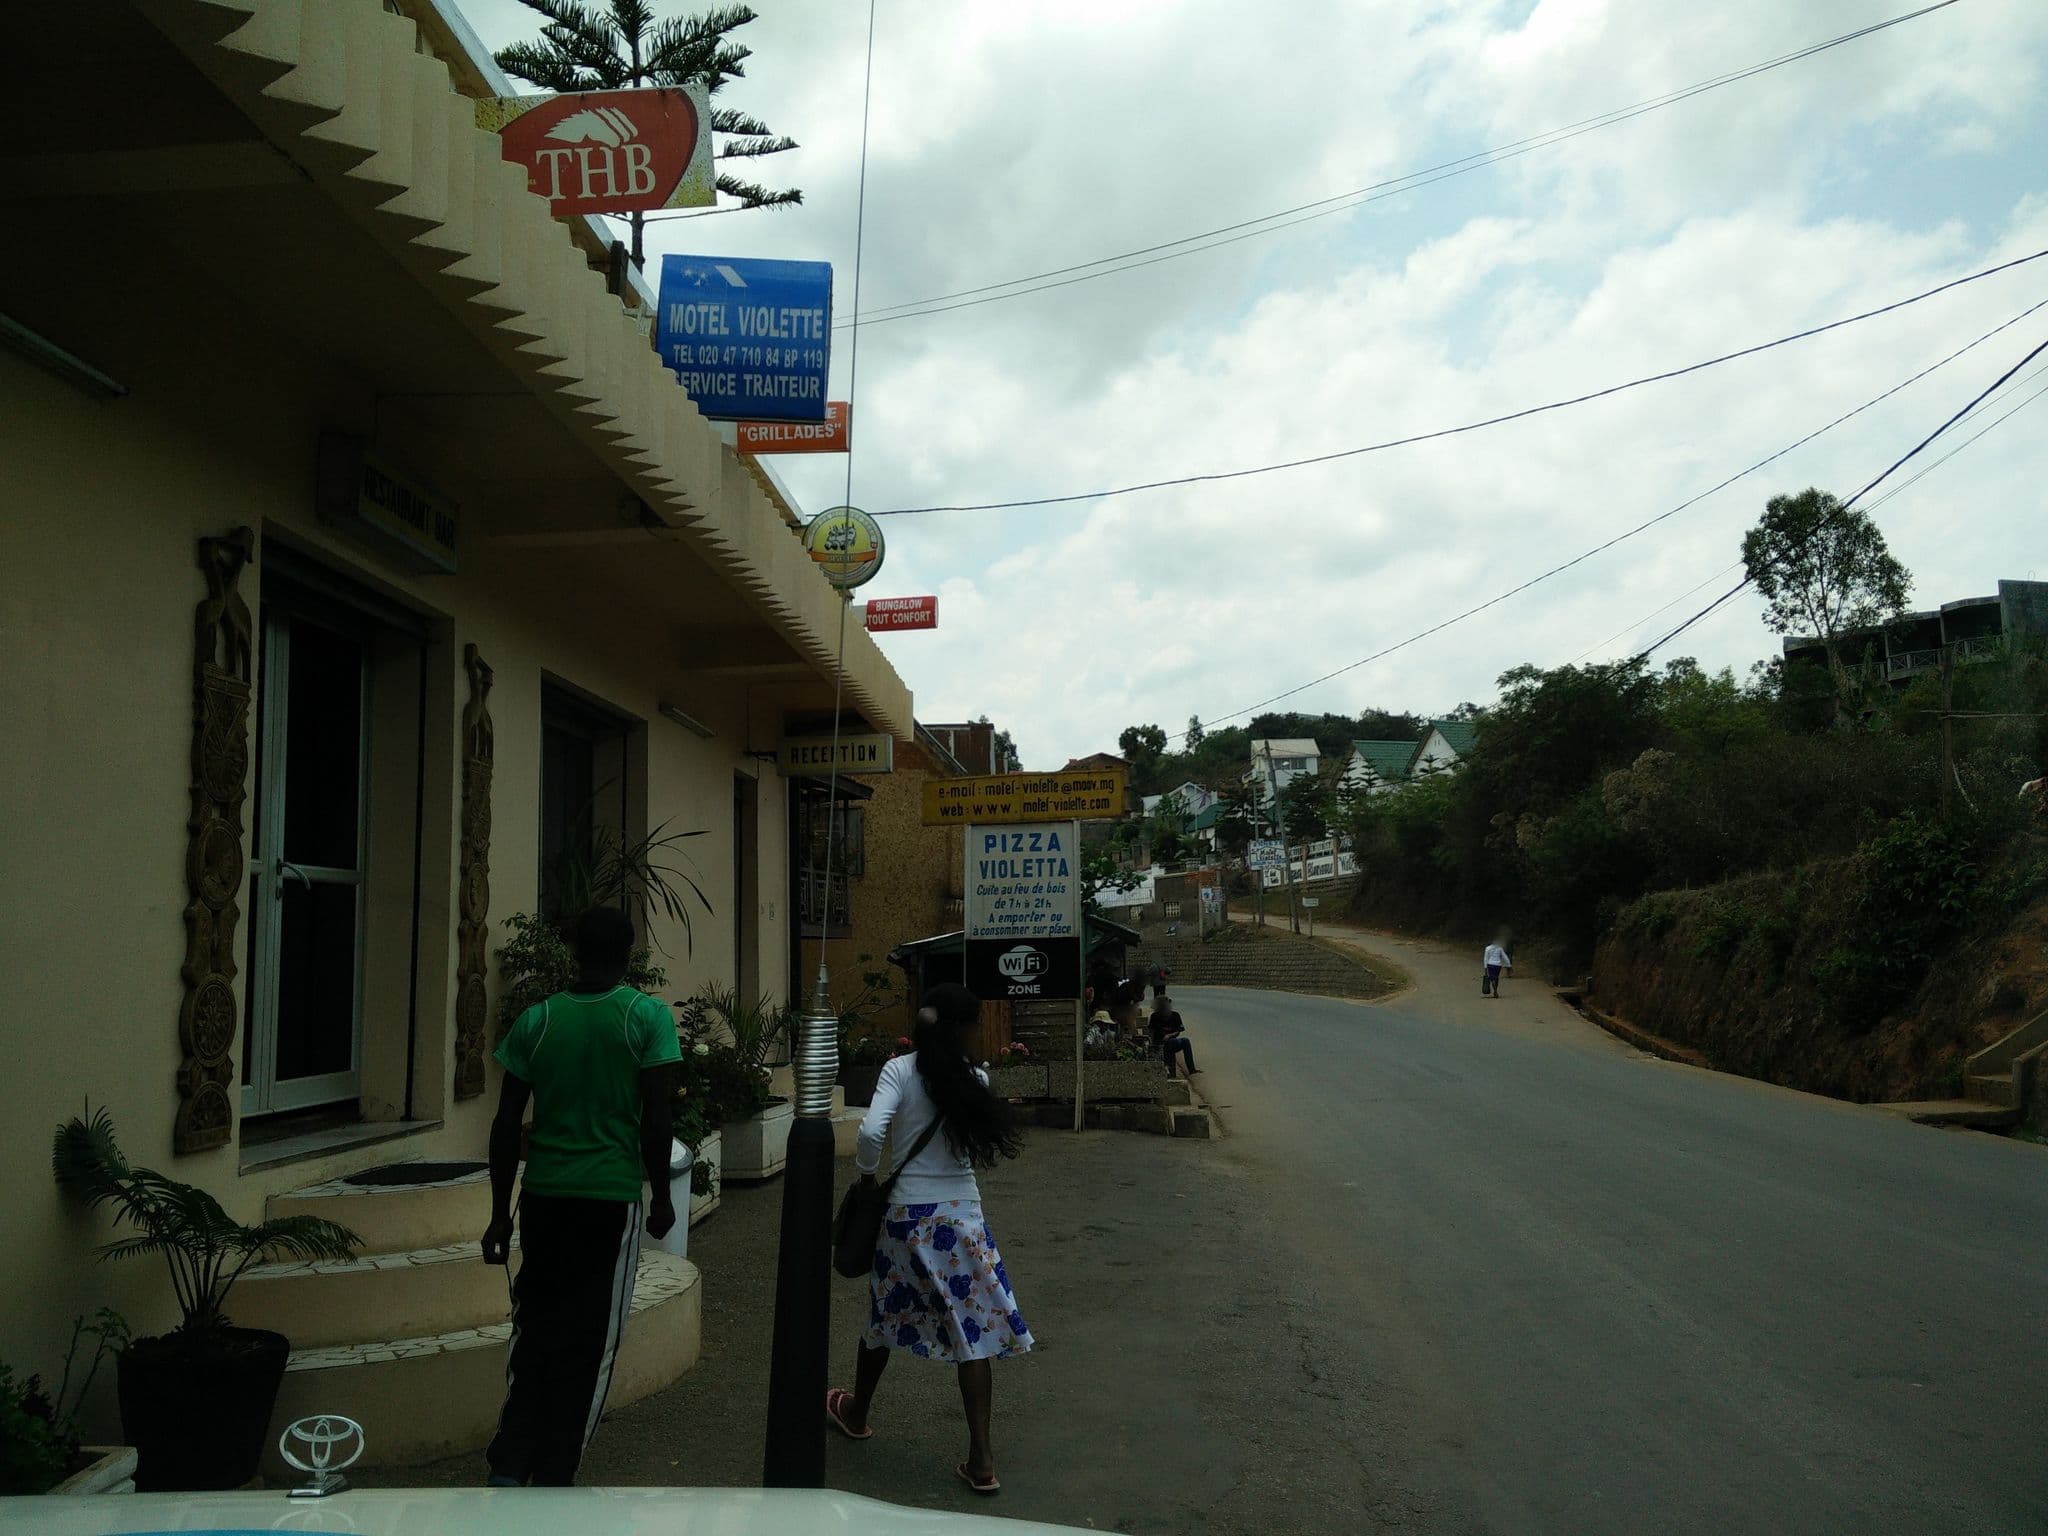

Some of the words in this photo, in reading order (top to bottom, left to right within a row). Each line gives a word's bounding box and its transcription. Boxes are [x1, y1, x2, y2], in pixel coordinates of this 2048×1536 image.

[536, 144, 656, 200] THB
[670, 304, 729, 334] MOTEL
[738, 306, 823, 339] VIOLETTE
[673, 344, 694, 364] TEL
[699, 345, 718, 365] 020
[723, 346, 736, 366] 47
[741, 347, 761, 366] 710
[766, 348, 779, 367] 84
[784, 349, 798, 368] BP
[804, 350, 823, 368] 119
[744, 374, 820, 398] TRAITEUR
[876, 600, 922, 611] BUNGALOW
[868, 614, 889, 624] TOUT
[892, 611, 931, 624] CONFORT
[984, 832, 1061, 854] PIZZA
[979, 858, 1069, 879] VIOLETTA
[1001, 885, 1012, 894] au
[1014, 883, 1030, 894] feu
[1032, 882, 1044, 894] de
[1046, 882, 1066, 894] bois
[994, 898, 1006, 909] de
[989, 913, 995, 923] A
[998, 911, 1045, 925] emporter
[1051, 913, 1063, 921] ou
[981, 926, 1030, 936] consommer
[1032, 926, 1047, 934] sur
[1049, 923, 1072, 936] place
[1007, 985, 1041, 995] ZONE
